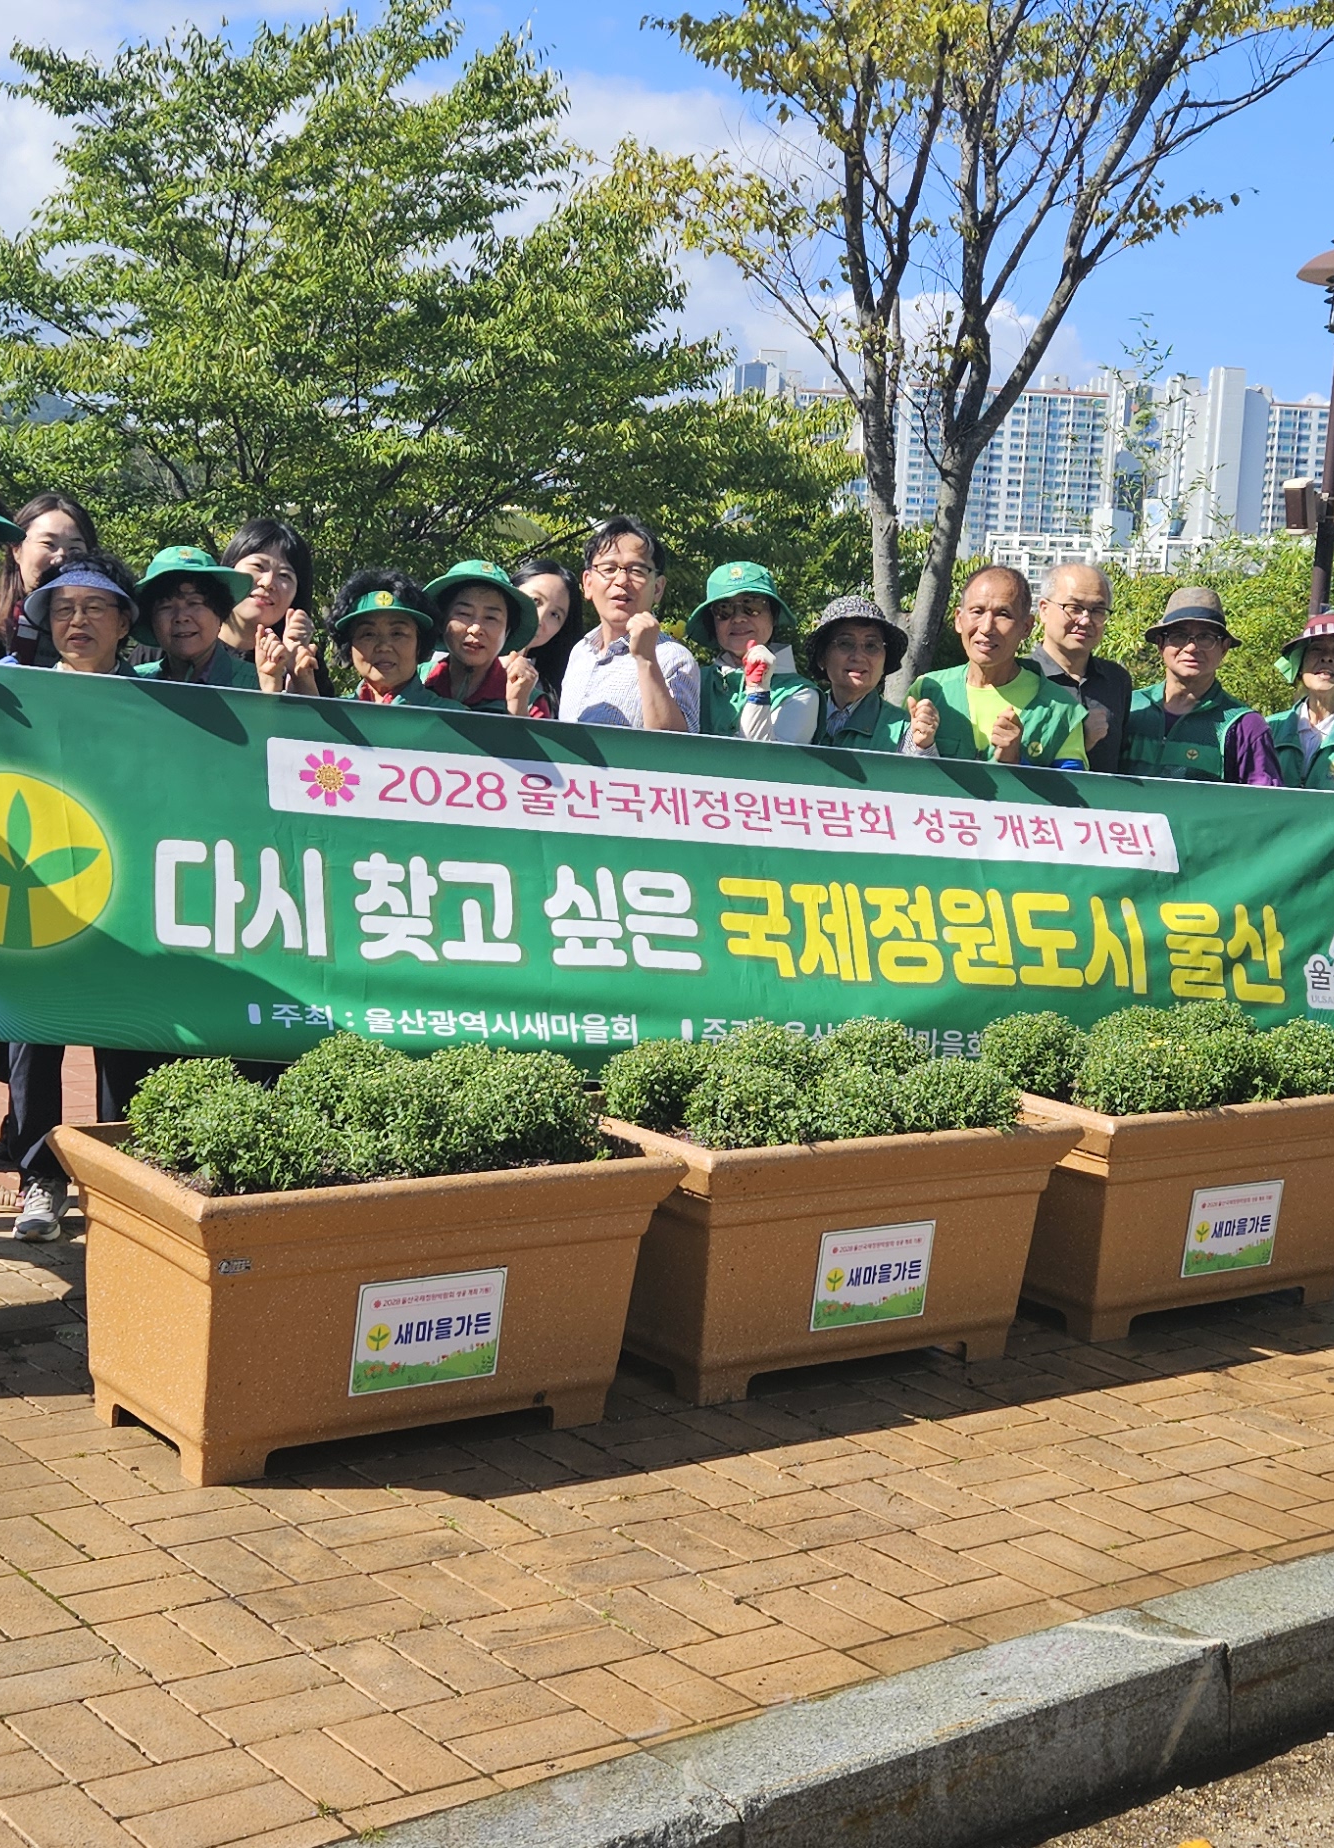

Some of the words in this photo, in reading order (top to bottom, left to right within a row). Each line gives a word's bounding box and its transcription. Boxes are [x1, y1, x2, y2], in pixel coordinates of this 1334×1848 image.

[378, 763, 508, 811] 2028
[517, 773, 897, 841] 울산국제정원박람회
[913, 807, 982, 847] 성공
[994, 814, 1064, 851] 개최
[1074, 820, 1156, 857] 기원!
[155, 838, 328, 957] 다시
[353, 852, 523, 963] 찾고
[544, 864, 703, 971] 싶은
[718, 877, 1147, 995] 국제정원도시
[1159, 901, 1285, 1004] 울산
[271, 1002, 334, 1031] 주최
[364, 1007, 639, 1046] 울산광역시새마을회
[1211, 1215, 1272, 1239] 새마을가든
[846, 1259, 922, 1287] 새마을가든
[394, 1312, 492, 1345] 새마을가든
